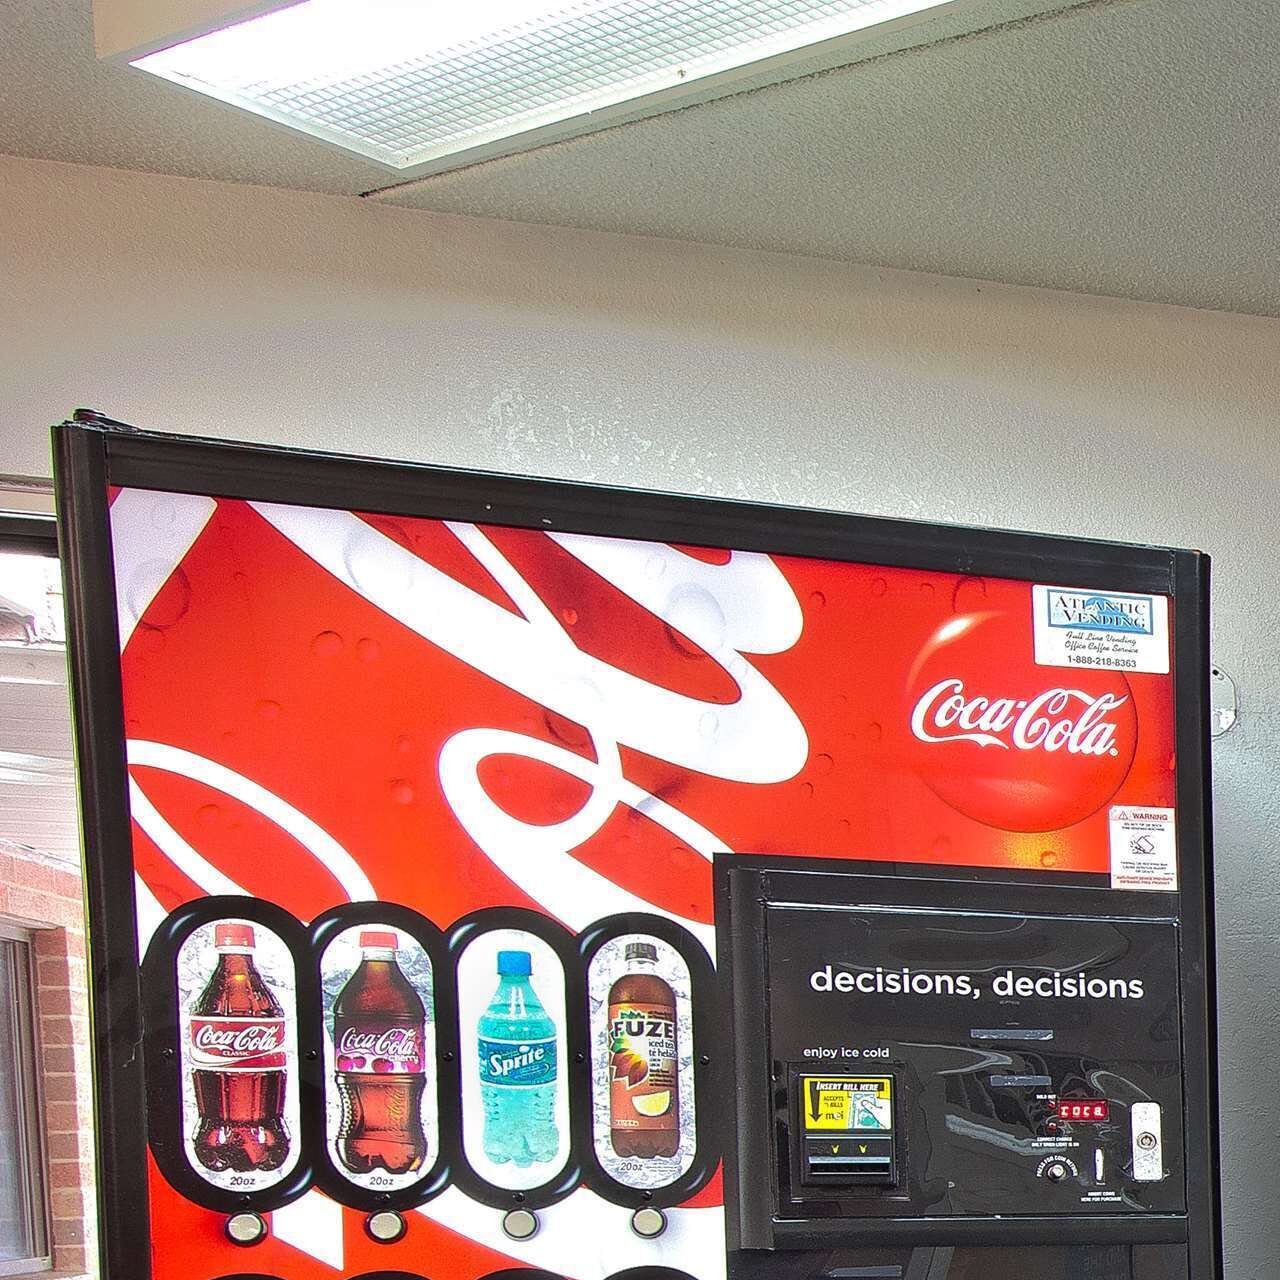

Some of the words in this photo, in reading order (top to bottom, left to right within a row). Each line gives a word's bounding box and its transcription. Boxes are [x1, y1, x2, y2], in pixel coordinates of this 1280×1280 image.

[1056, 596, 1146, 616] ATLANTIC
[1063, 610, 1145, 628] VENDING
[1105, 634, 1137, 646] Vending
[1067, 655, 1137, 668] 1-888-218-8363
[910, 678, 1128, 757] Coca-Cola
[809, 965, 981, 1000] decisions,
[991, 970, 1144, 999] decisions
[614, 1020, 674, 1039] FUZE
[195, 1024, 281, 1053] Coca-Cola
[340, 1026, 417, 1056] Coca-Cola
[222, 1049, 249, 1057] CLASSIC
[388, 1054, 418, 1065] cherry
[803, 1046, 837, 1059] enjoy
[841, 1047, 859, 1057] ice
[863, 1047, 889, 1058] cold
[490, 1045, 545, 1076] Sprite
[816, 1081, 841, 1091] INSERT
[229, 1175, 256, 1186] 20oz
[369, 1175, 394, 1186] 20oz
